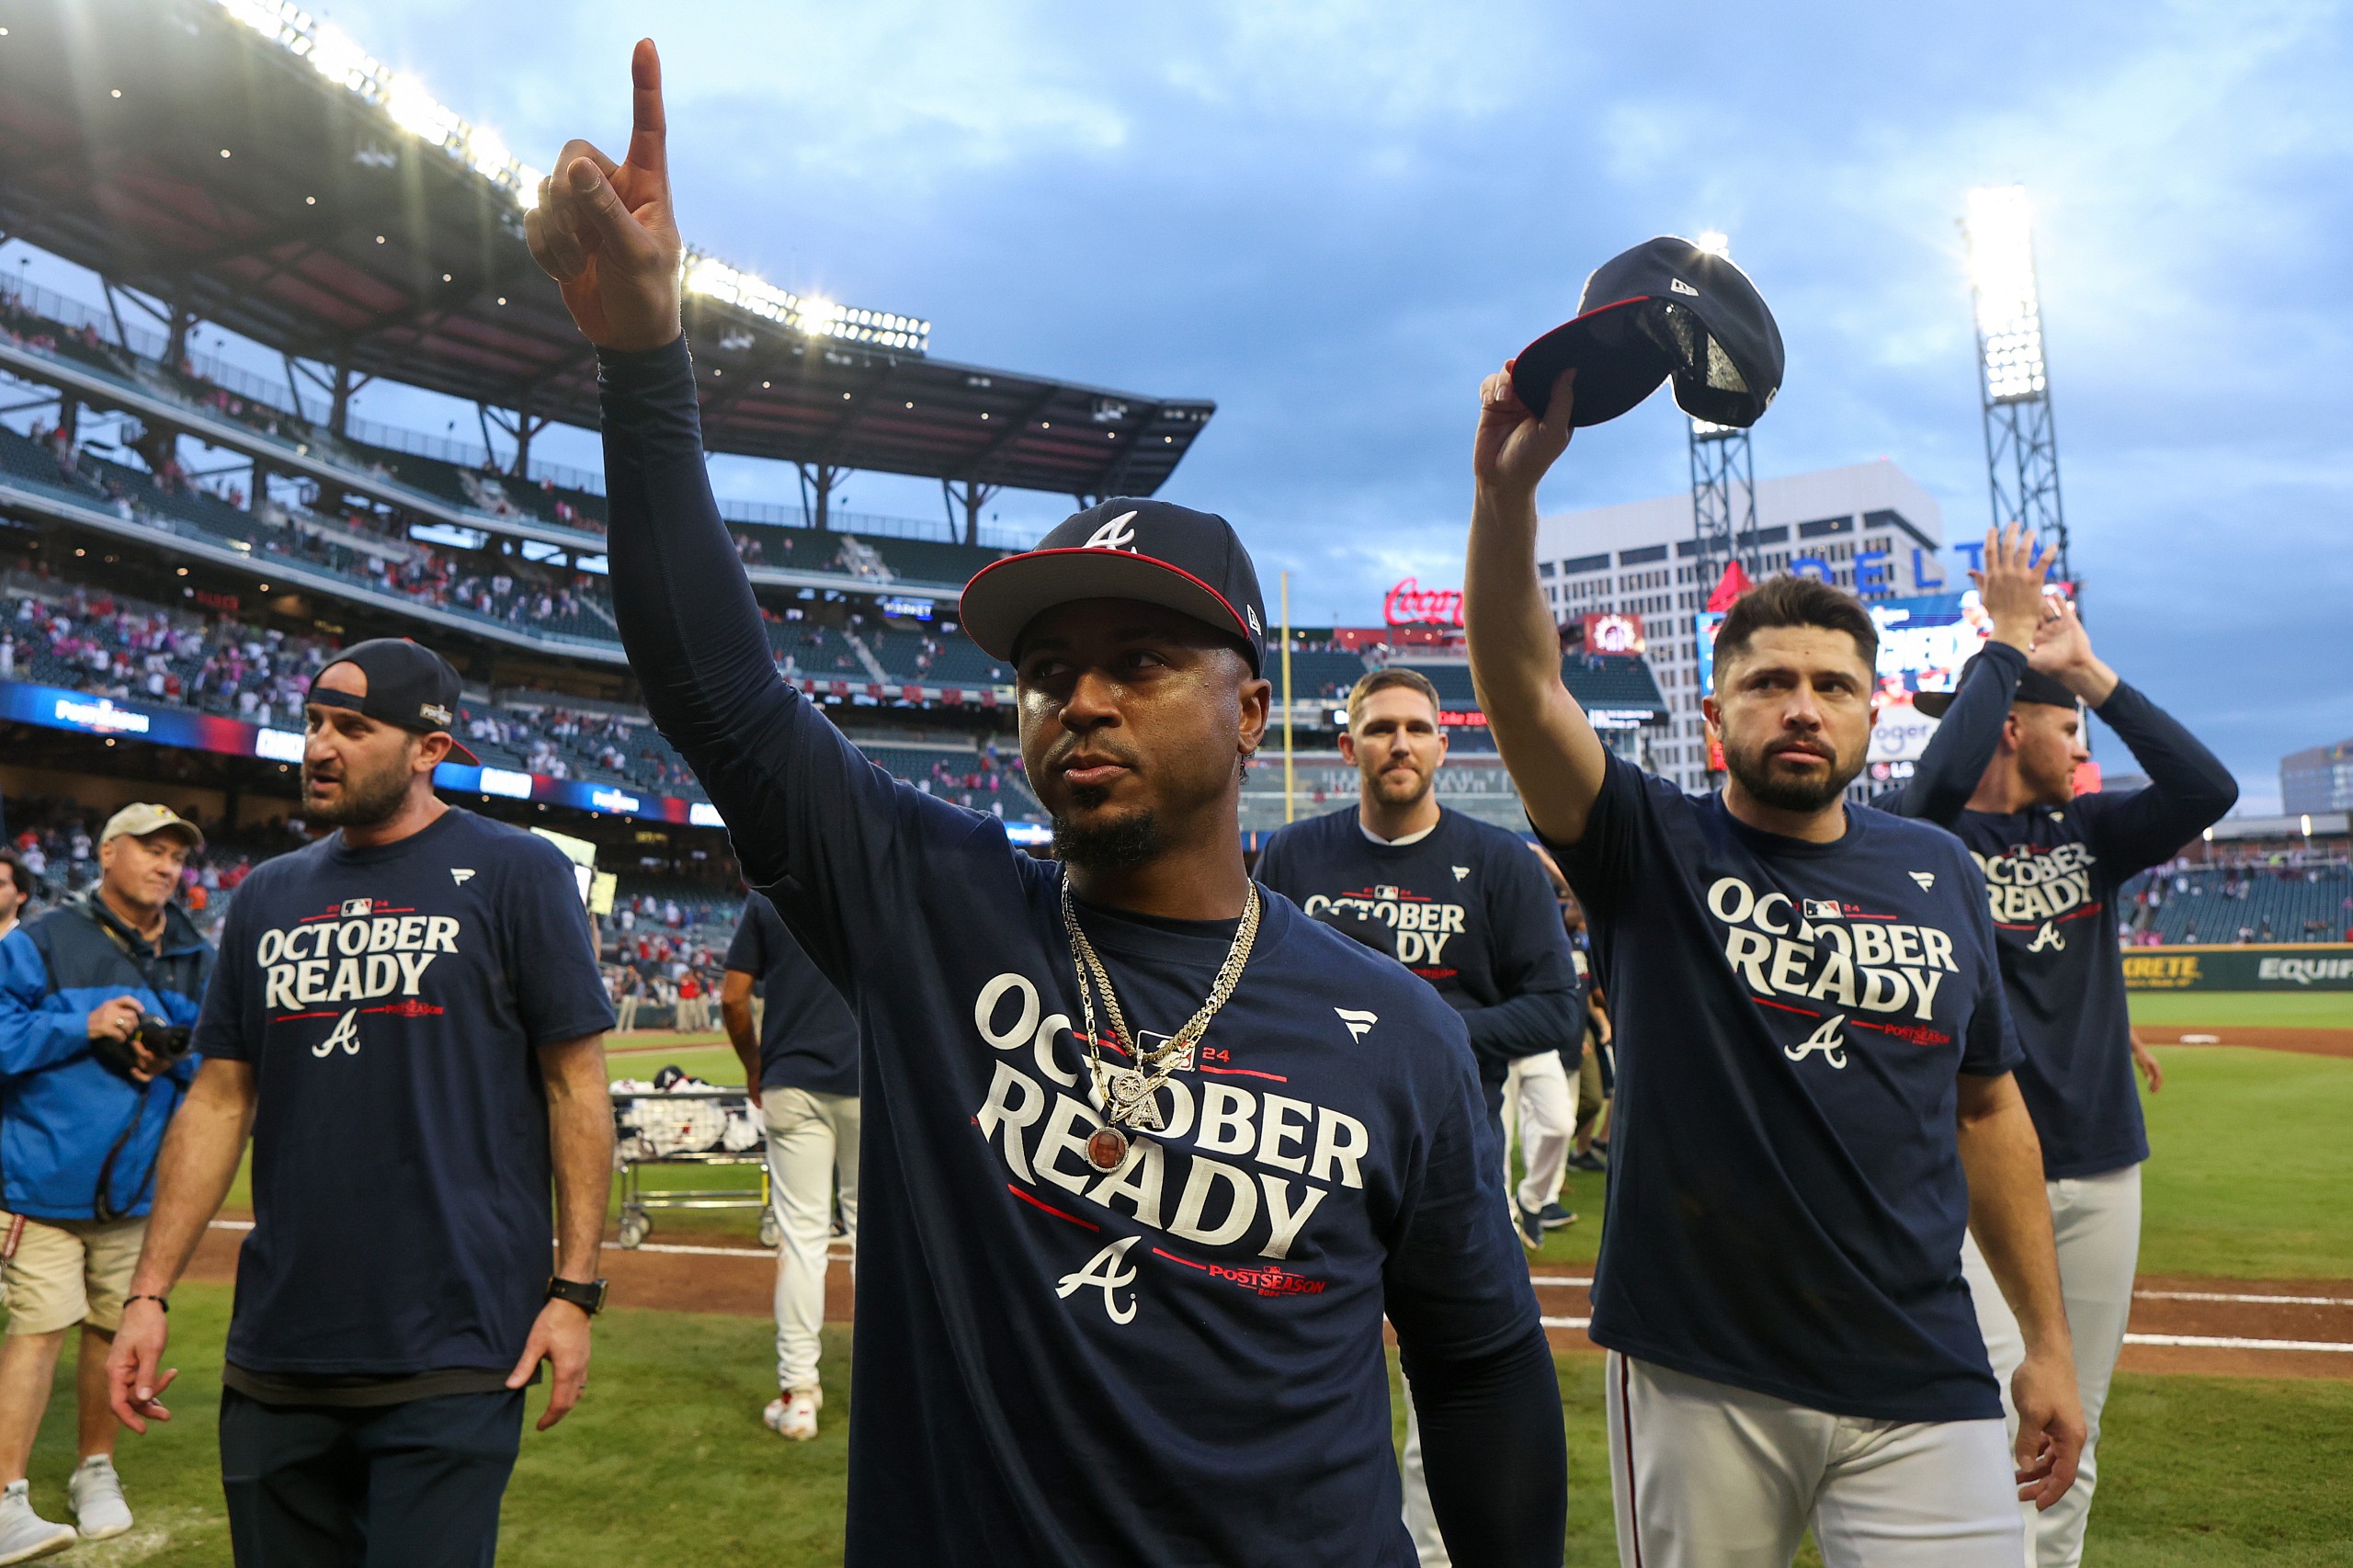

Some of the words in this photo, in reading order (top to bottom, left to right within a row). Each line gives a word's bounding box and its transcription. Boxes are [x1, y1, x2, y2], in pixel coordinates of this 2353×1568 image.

[1383, 576, 1464, 626] Coca
[1875, 721, 1930, 755] oger
[1890, 762, 1915, 778] LG
[1985, 869, 2093, 924] READY
[256, 915, 460, 969] OCTOBER
[266, 952, 438, 1011] READY
[1724, 926, 1944, 1021] READY
[311, 1007, 361, 1058] A
[1201, 1046, 1232, 1062] 24
[1784, 1014, 1848, 1069] A
[1884, 1023, 1951, 1045] POSTSEASON
[974, 972, 1370, 1189] OCTOBER
[976, 1059, 1328, 1260] READY
[1055, 1235, 1142, 1324] A
[1209, 1264, 1326, 1295] POSTSEASON
